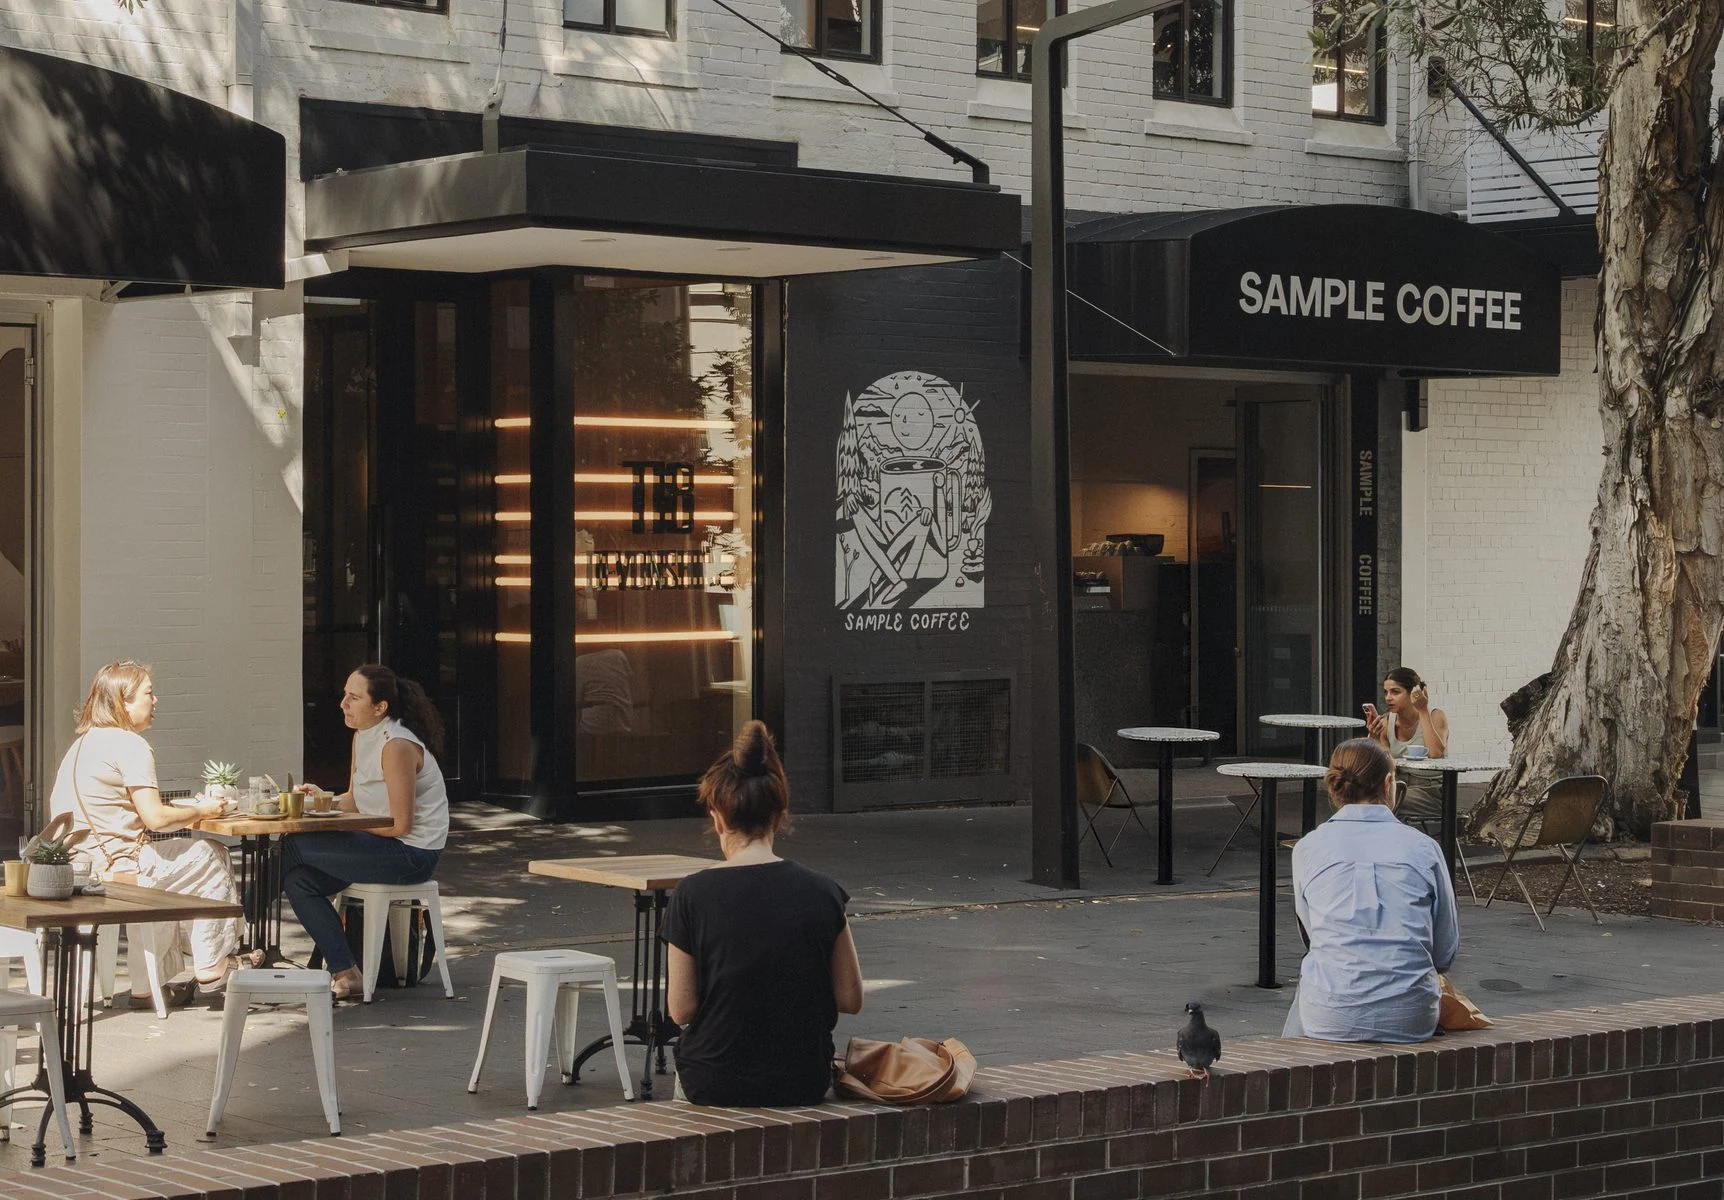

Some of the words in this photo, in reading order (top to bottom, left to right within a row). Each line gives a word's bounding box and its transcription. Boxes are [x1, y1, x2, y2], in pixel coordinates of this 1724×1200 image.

[1239, 271, 1385, 321] SAMPLE
[1396, 282, 1522, 330] COFFEE
[1359, 450, 1373, 517] SAMPLE
[1358, 554, 1373, 615] COFFEE
[844, 612, 903, 632] SAMPLE
[910, 611, 970, 631] COFFEE
